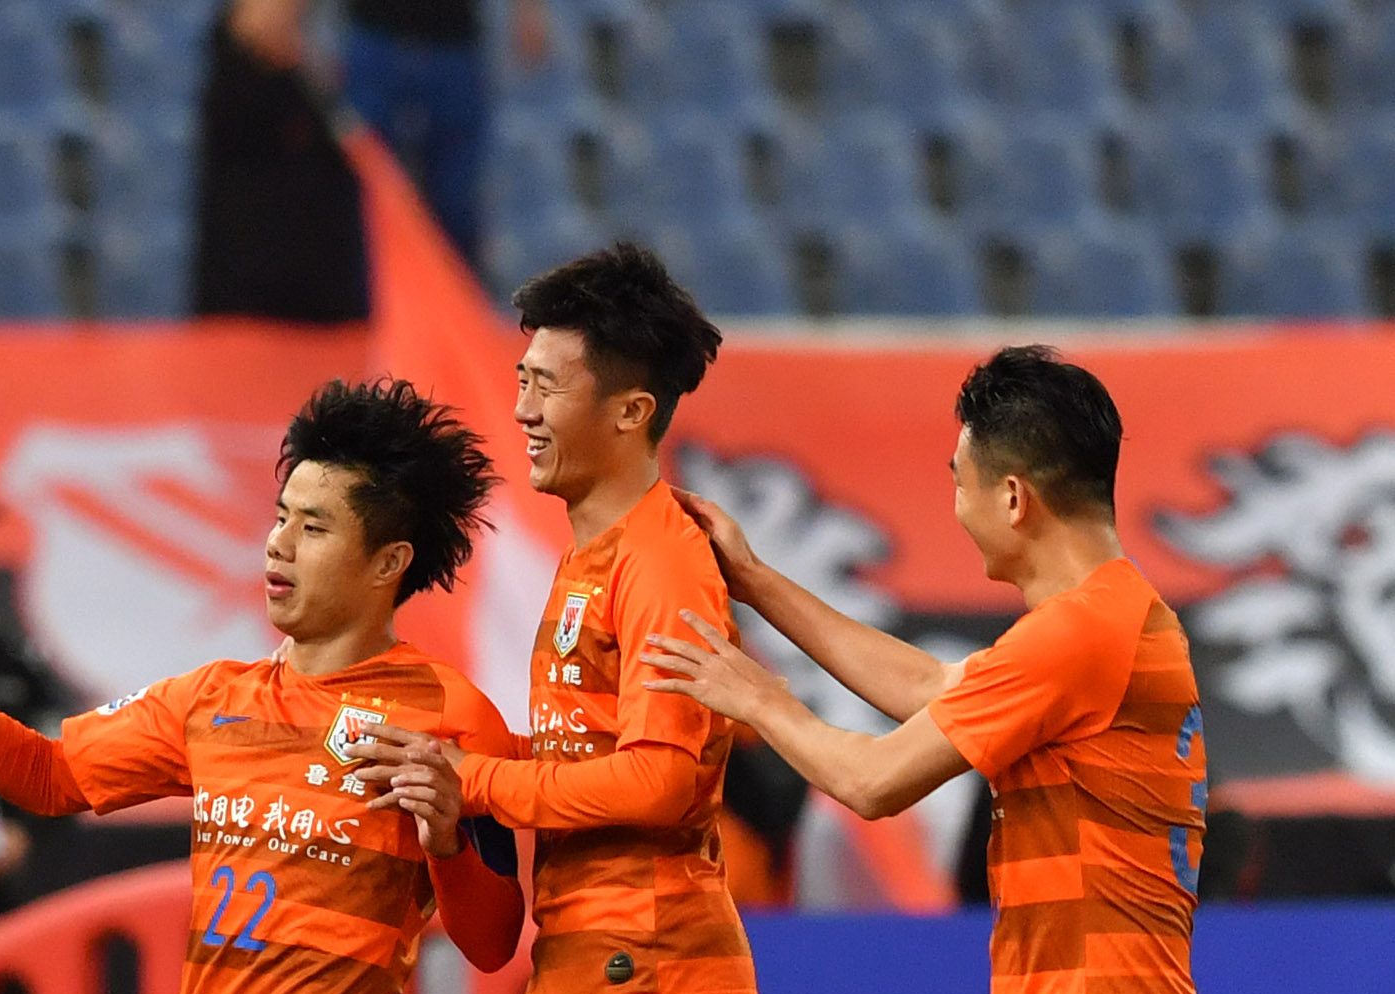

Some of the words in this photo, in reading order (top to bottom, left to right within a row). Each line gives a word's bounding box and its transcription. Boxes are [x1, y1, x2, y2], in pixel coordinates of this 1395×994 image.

[216, 830, 257, 847] Power
[268, 837, 300, 854] Our
[306, 845, 351, 866] Care
[202, 866, 276, 951] 22
